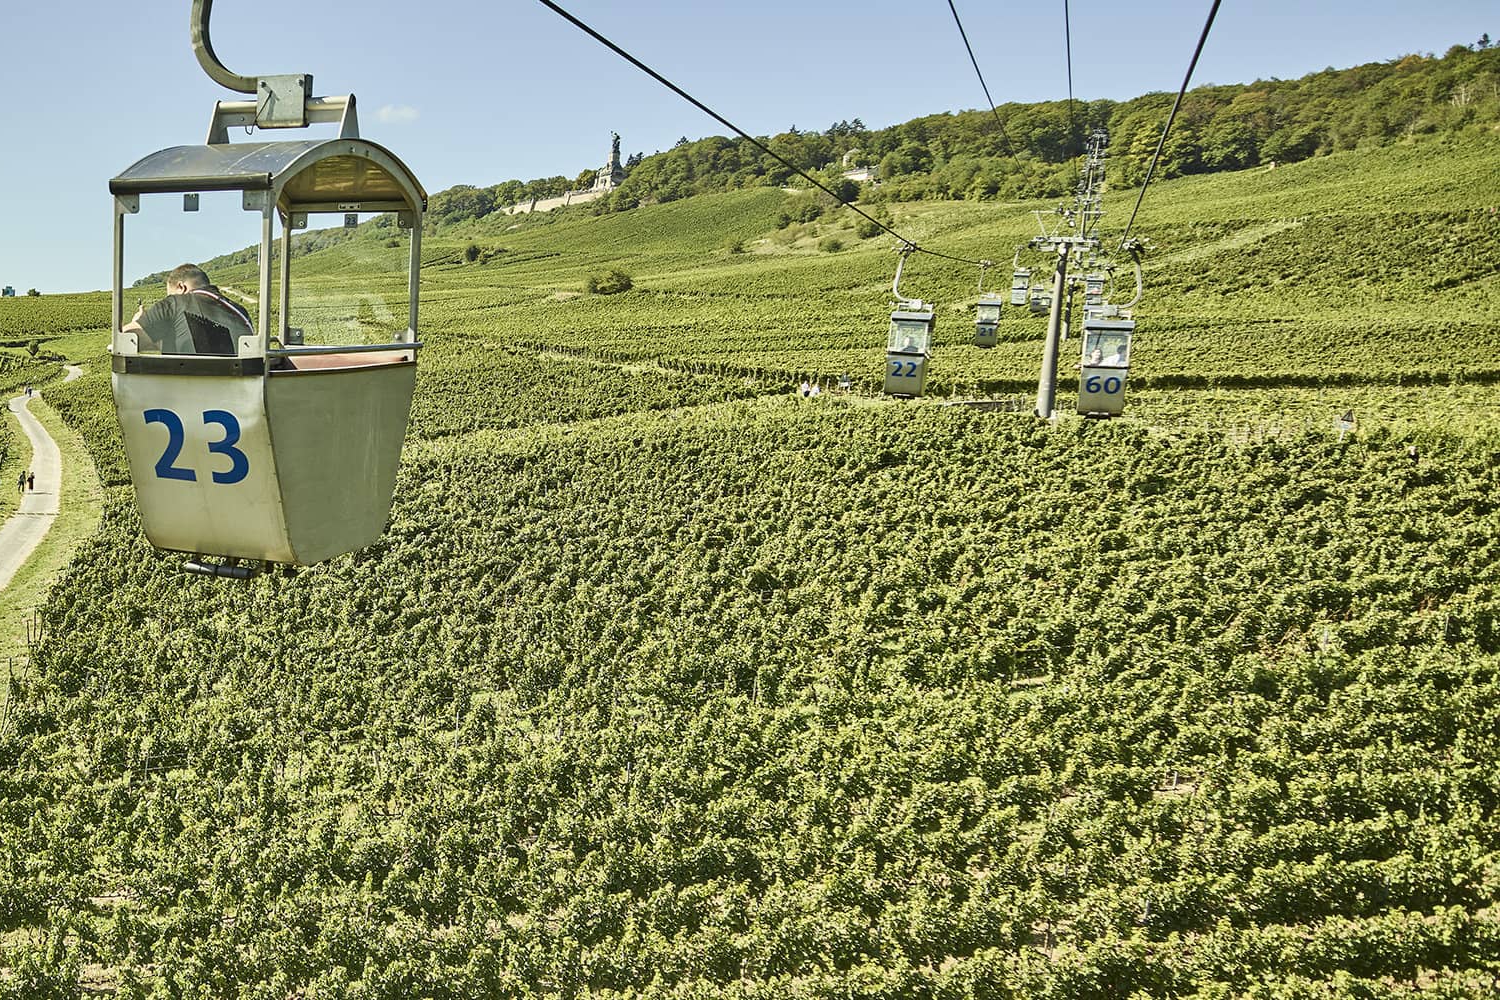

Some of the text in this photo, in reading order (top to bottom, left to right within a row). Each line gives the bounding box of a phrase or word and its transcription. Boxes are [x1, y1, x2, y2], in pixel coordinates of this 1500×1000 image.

[346, 216, 357, 225] 23
[979, 327, 993, 336] 21
[891, 361, 917, 377] 22
[1086, 376, 1121, 394] 60
[143, 408, 249, 484] 23
